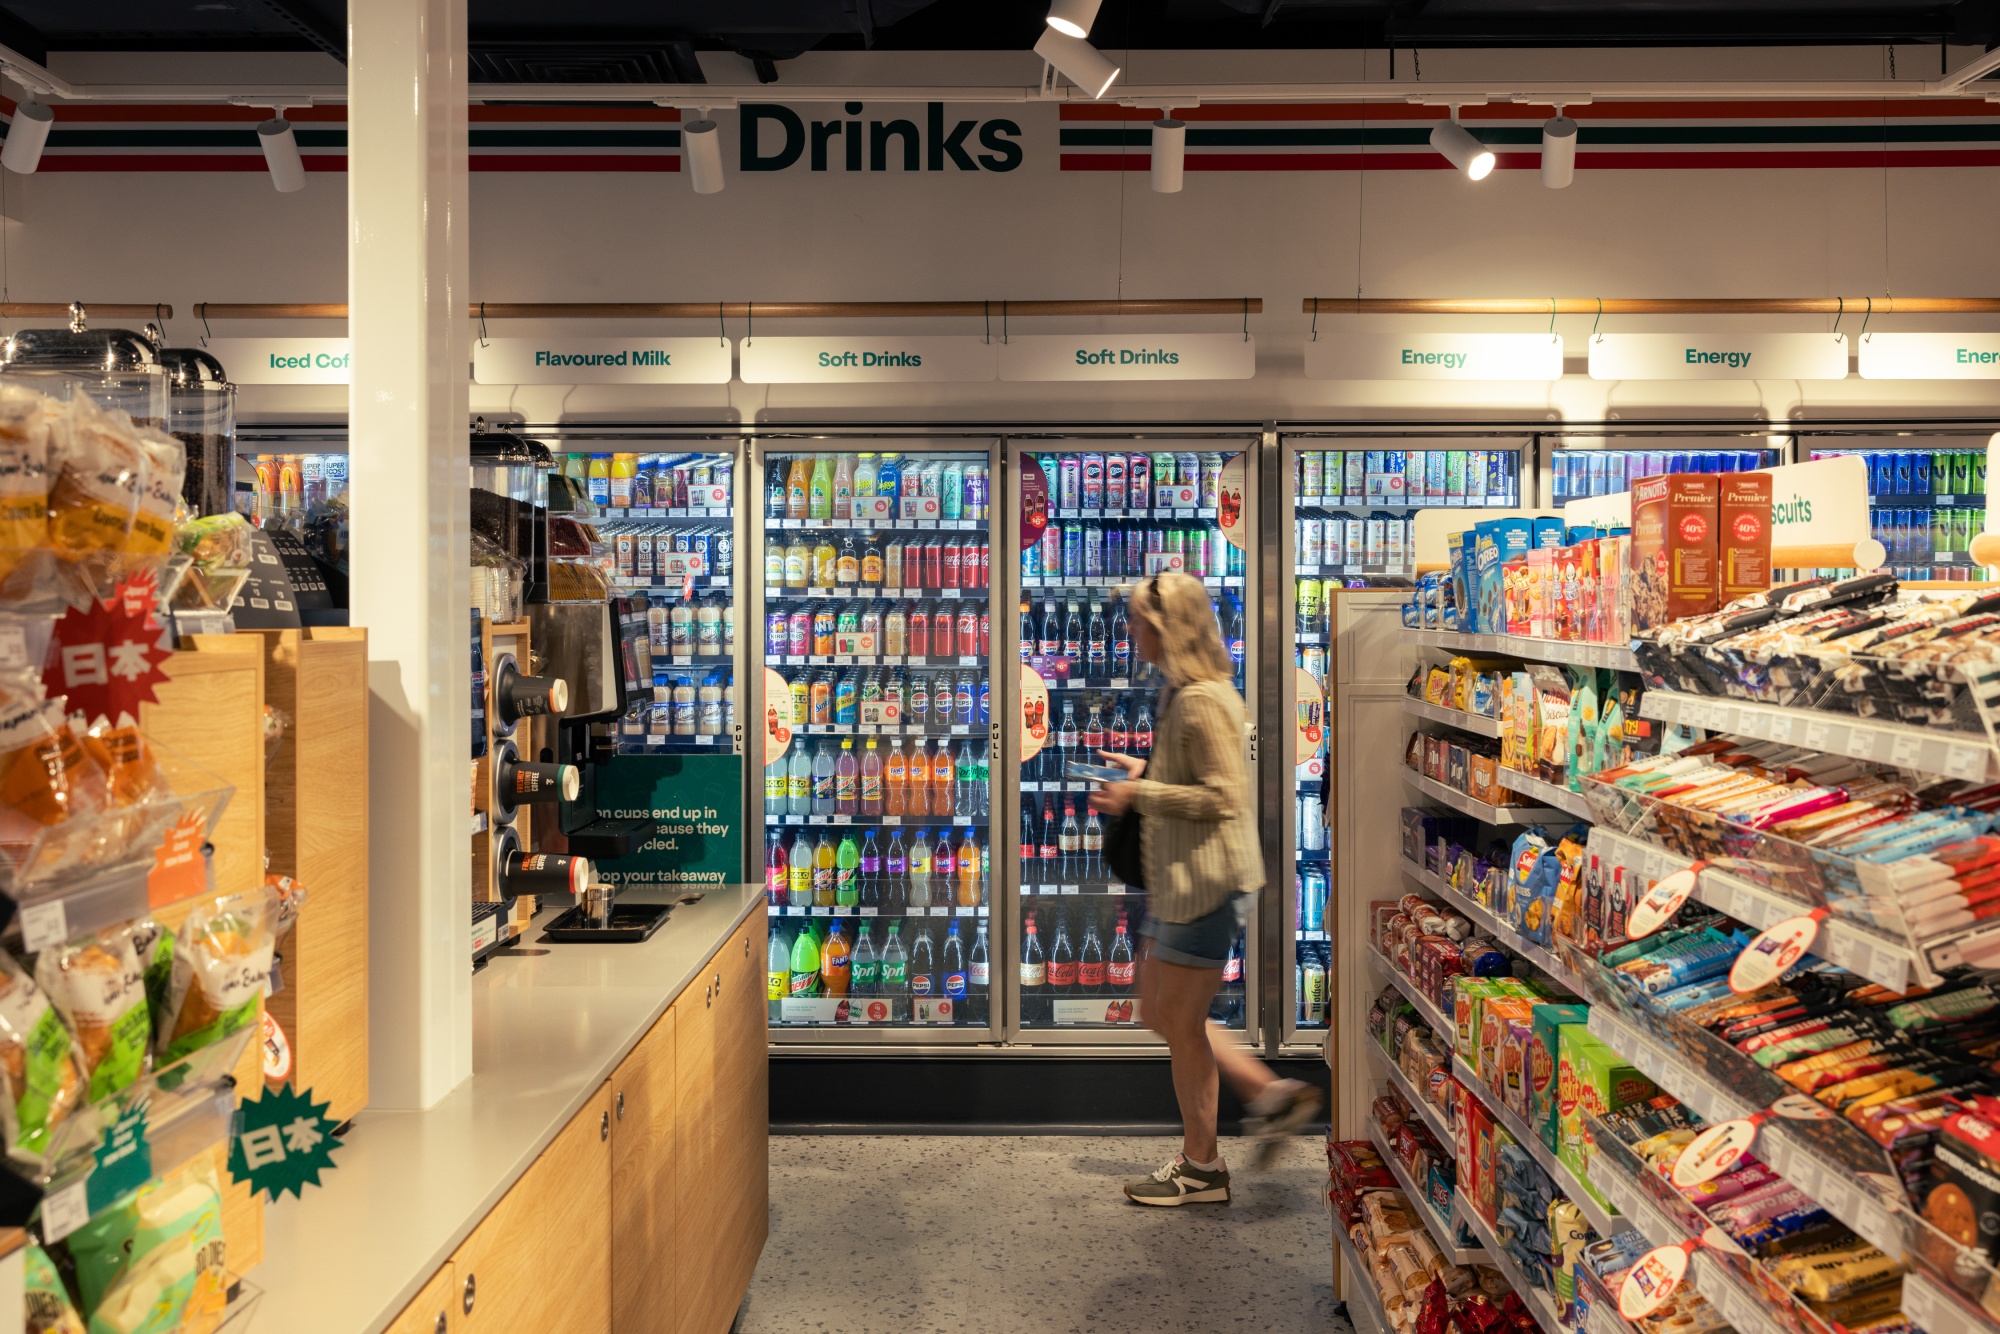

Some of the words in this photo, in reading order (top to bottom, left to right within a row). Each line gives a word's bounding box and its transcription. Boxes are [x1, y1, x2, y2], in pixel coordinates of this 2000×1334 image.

[740, 101, 1023, 172] Drinks
[269, 353, 311, 369] Iced
[535, 350, 628, 367] Flavoured
[632, 350, 671, 366] Milk
[818, 350, 858, 367] Soft
[862, 350, 922, 367] Drinks
[1075, 348, 1116, 365] Soft
[1120, 348, 1179, 365] Drinks
[1402, 349, 1468, 368] Energy
[1685, 348, 1752, 368] Energy
[1638, 481, 1668, 500] ARNOTT'S
[1674, 493, 1715, 503] Premier
[1727, 492, 1768, 502] Premier
[1680, 514, 1707, 530] CHOCOLATE
[1684, 523, 1703, 533] 40%
[1733, 513, 1761, 529] CHOCOLATE
[1737, 522, 1756, 533] 40%
[1737, 533, 1755, 541] CHIPS
[1477, 546, 1498, 571] OREO
[61, 640, 151, 689] 日本
[1309, 732, 1318, 740] $8
[531, 771, 539, 792] COFFEE
[652, 806, 680, 819] end
[682, 809, 702, 822] up
[704, 806, 717, 819] in
[696, 822, 730, 838] they
[637, 838, 679, 853] cled.
[623, 872, 656, 884] your
[657, 869, 726, 884] takeaway
[1312, 978, 1321, 1014] mother
[1559, 1072, 1580, 1102] Biskit
[239, 1116, 325, 1171] 日本
[1569, 1229, 1598, 1241] CORN
